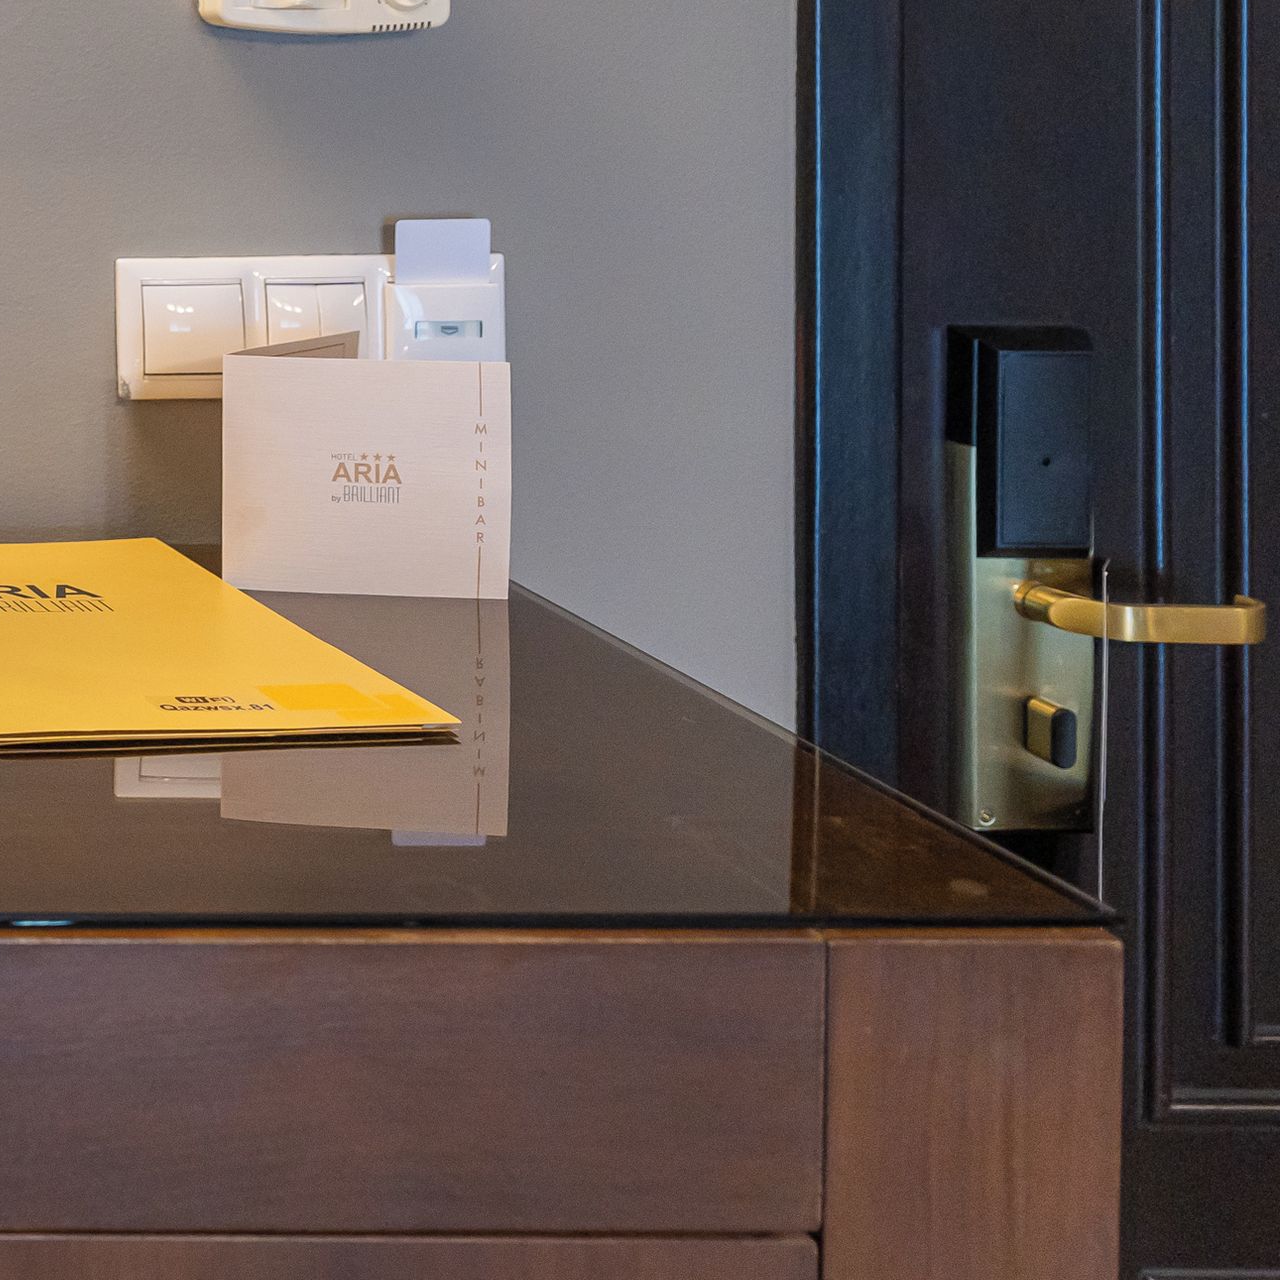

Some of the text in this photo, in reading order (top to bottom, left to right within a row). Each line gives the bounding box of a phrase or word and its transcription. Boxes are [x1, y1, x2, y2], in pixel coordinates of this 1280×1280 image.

[331, 453, 357, 461] HOTEL
[331, 462, 402, 485] ARIA
[474, 423, 488, 544] MINIBAR
[331, 485, 400, 504] by BRILLIANT
